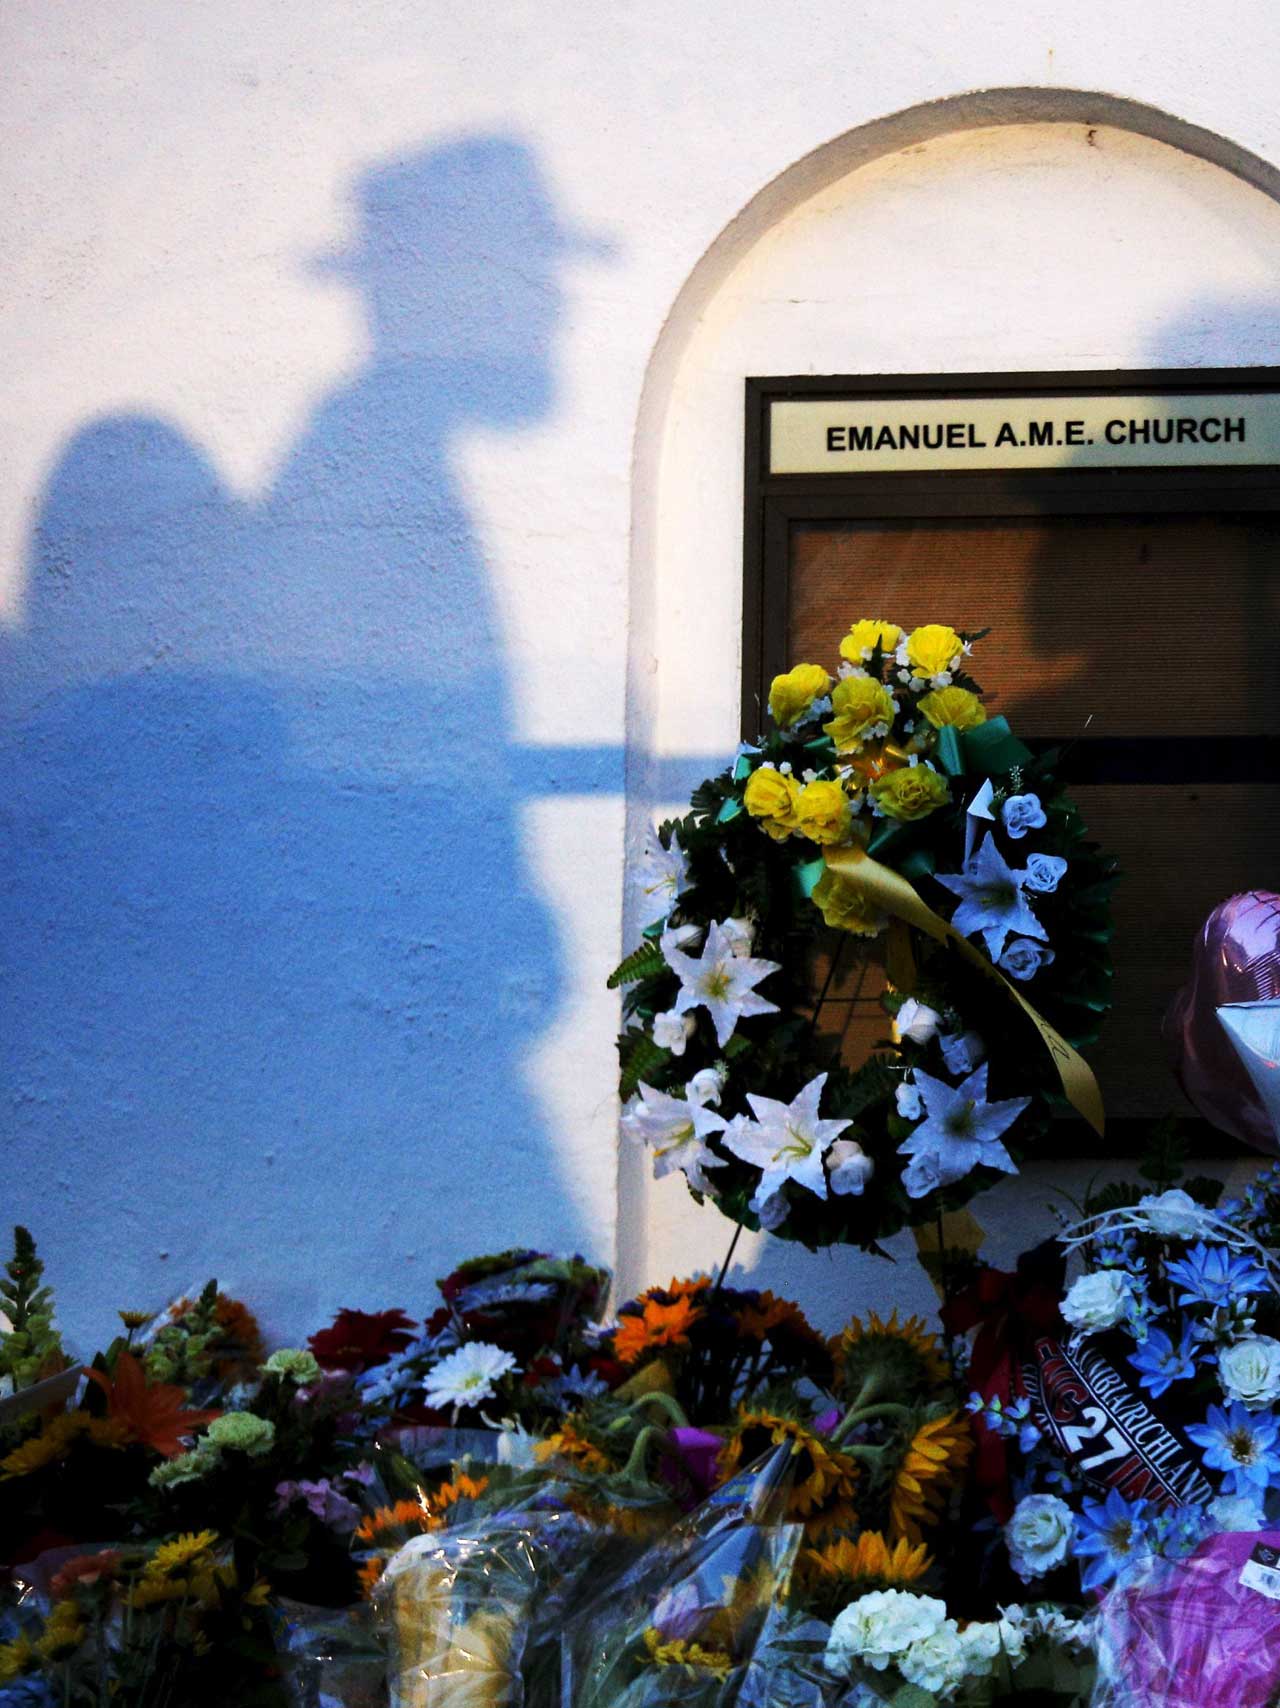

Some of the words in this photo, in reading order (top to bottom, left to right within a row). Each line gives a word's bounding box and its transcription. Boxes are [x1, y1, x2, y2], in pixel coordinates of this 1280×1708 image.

[828, 424, 986, 451] EMANUEL
[995, 421, 1093, 446] A.M.E.
[1105, 418, 1245, 445] CHURCH
[1060, 1406, 1132, 1471] 27
